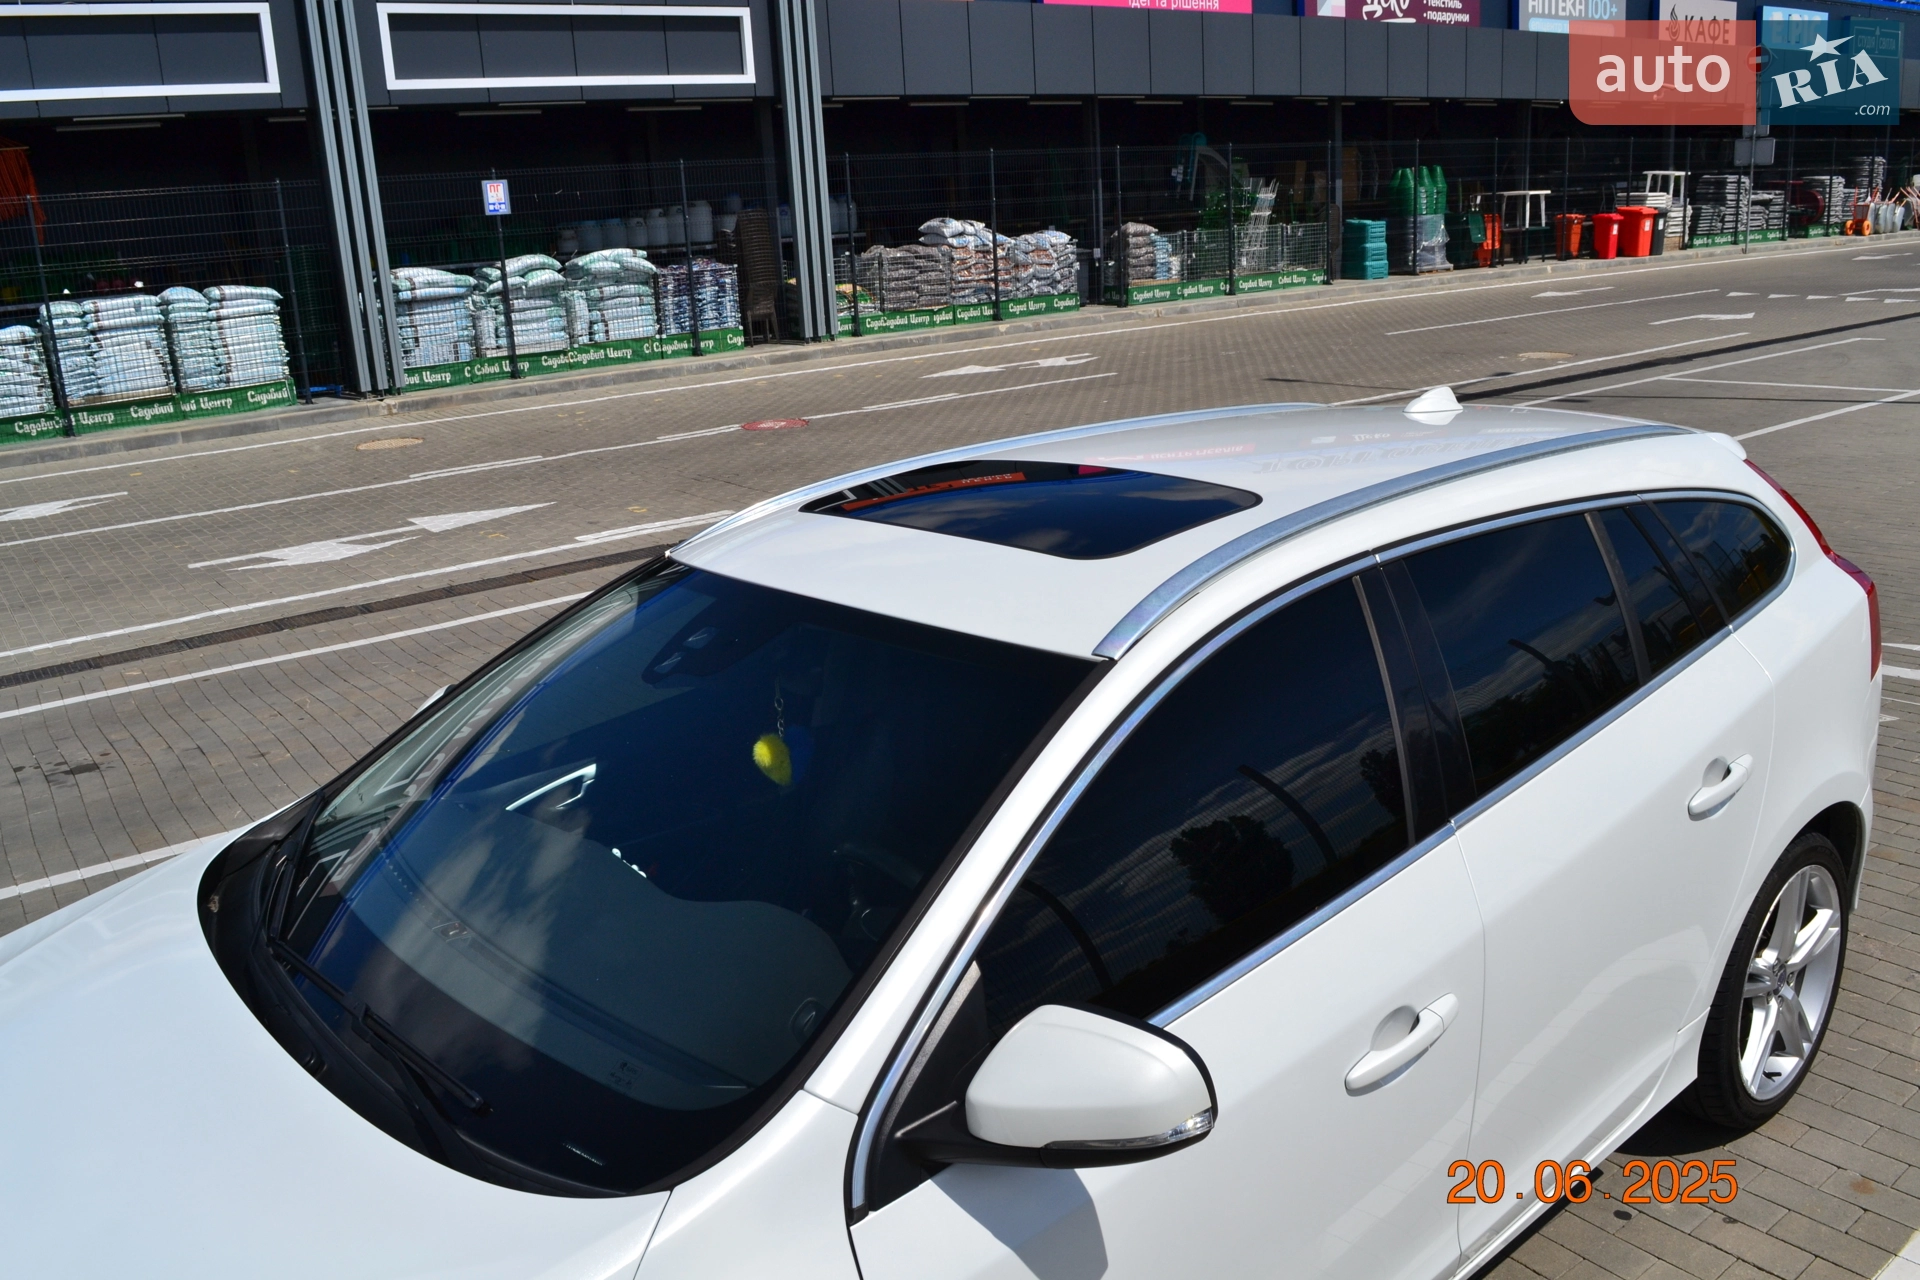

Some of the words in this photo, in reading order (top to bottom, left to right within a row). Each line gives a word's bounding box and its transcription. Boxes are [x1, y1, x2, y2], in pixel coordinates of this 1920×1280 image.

[1426, 11, 1470, 24] подарунки
[1528, 0, 1585, 17] АПТЕКА
[1588, 0, 1618, 20] 100+
[1684, 14, 1730, 44] КАФЕ
[422, 370, 452, 384] Центр
[200, 396, 233, 409] Центр
[246, 387, 289, 405] Садовий
[79, 411, 115, 425] Центр
[129, 401, 174, 420] Садовий
